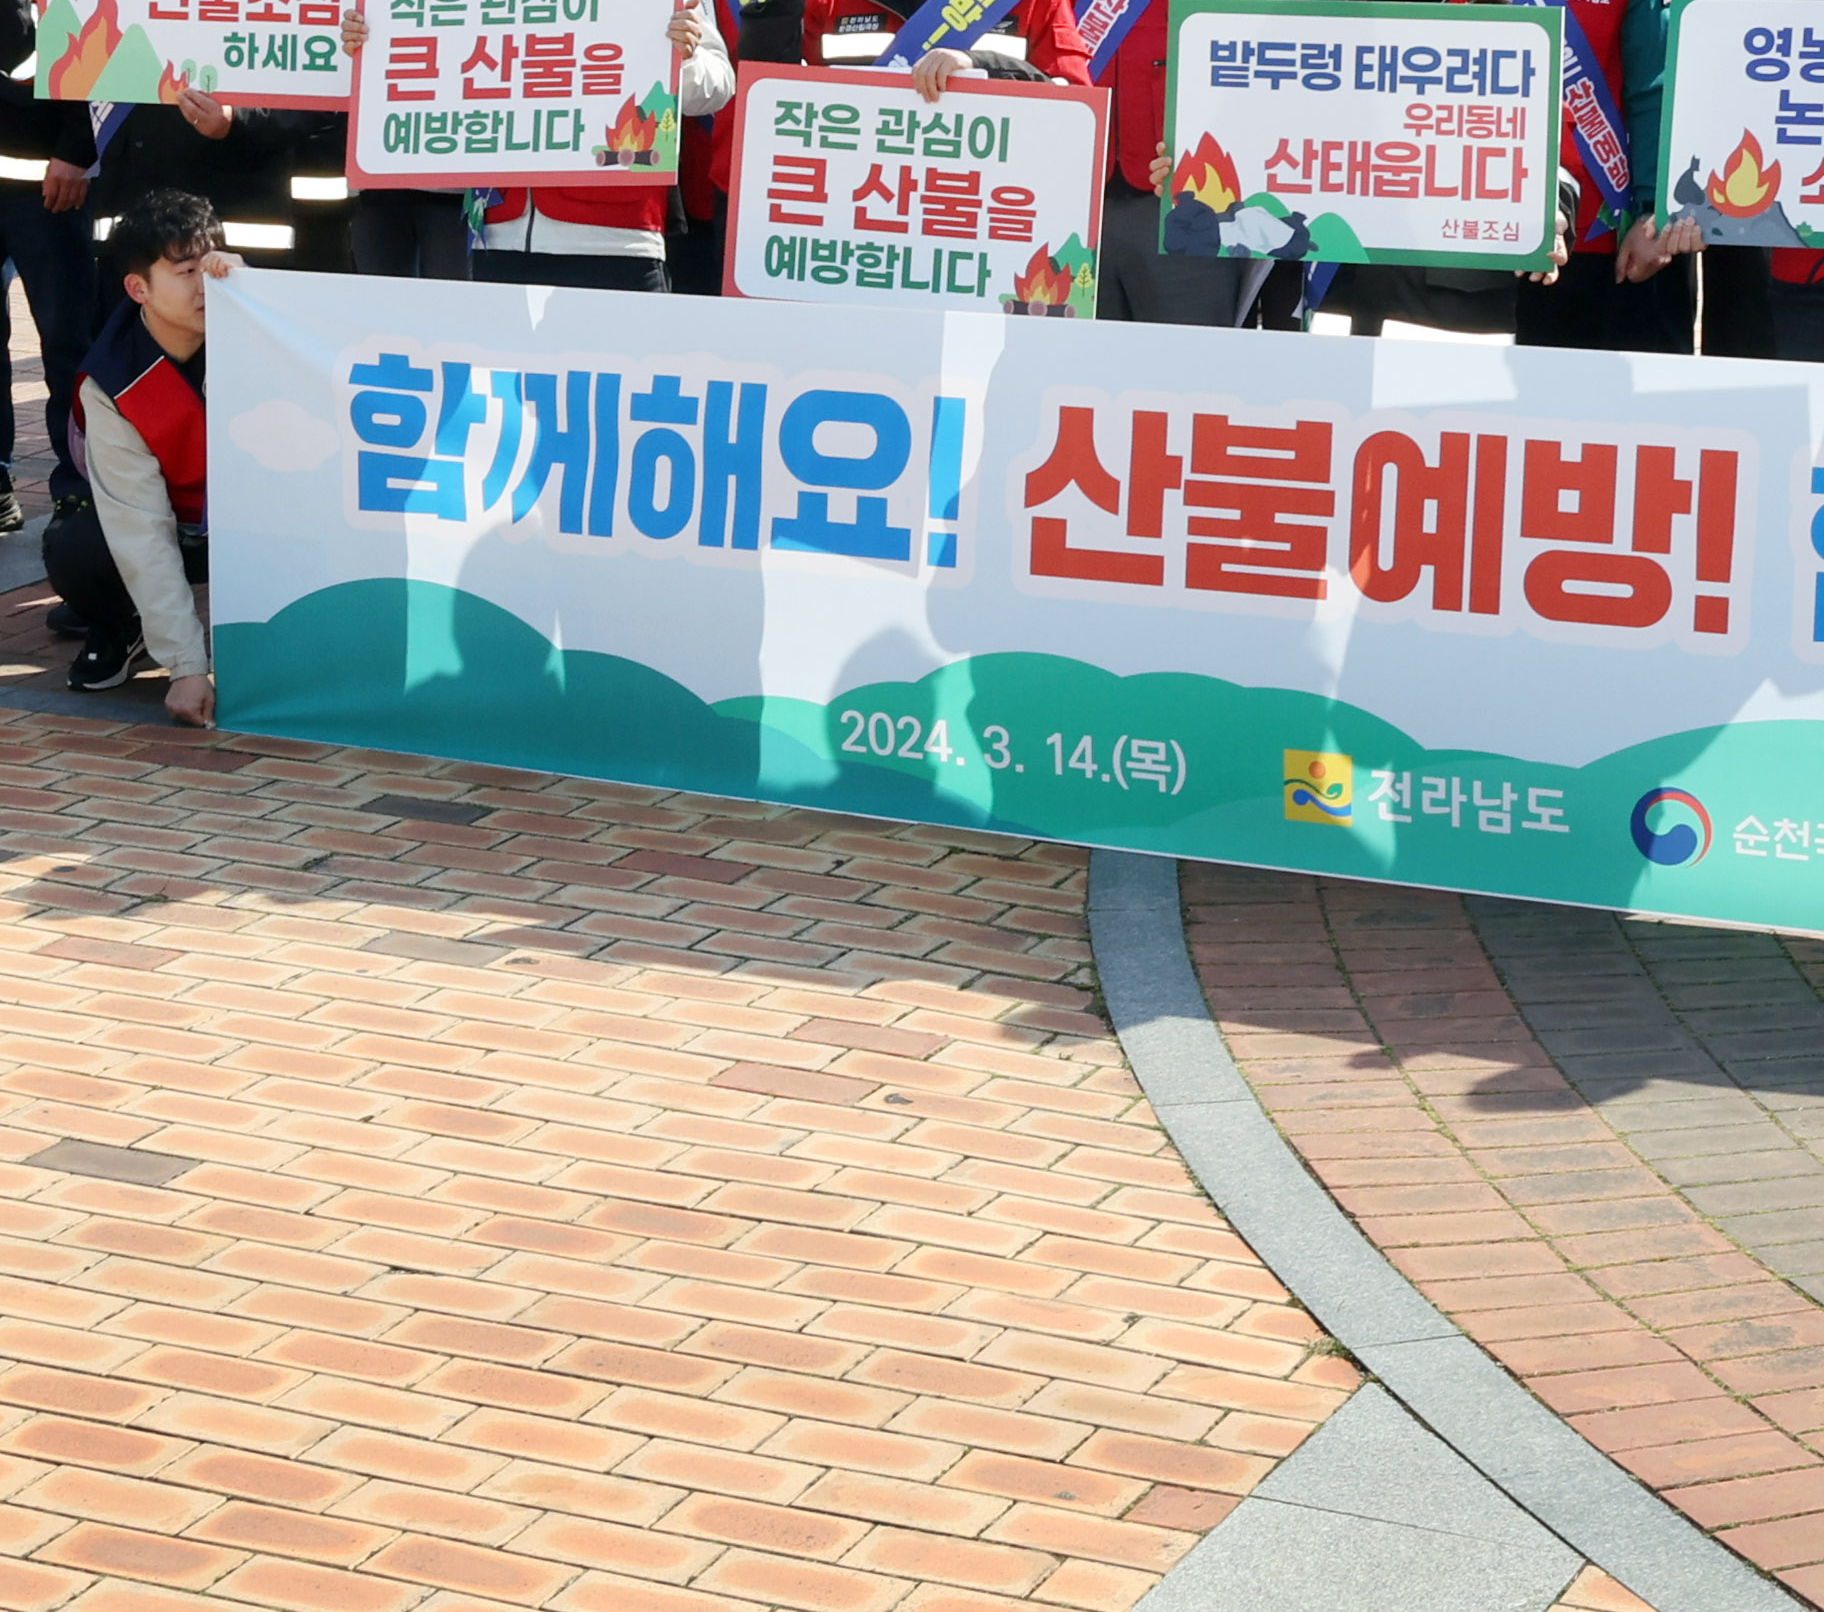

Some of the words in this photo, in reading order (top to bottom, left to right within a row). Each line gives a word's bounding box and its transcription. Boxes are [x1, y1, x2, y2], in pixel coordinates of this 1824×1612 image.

[223, 31, 338, 72] 하세요
[384, 37, 440, 102] 큰
[460, 33, 624, 97] 산불을
[1209, 40, 1341, 90] 밭두렁
[1354, 46, 1535, 97] 태우려다
[383, 108, 585, 154] 예방합니다
[774, 101, 861, 152] 작은
[876, 106, 1010, 162] 관심이
[1403, 104, 1526, 141] 우리동네
[1565, 77, 1630, 192] 산불예방
[767, 156, 828, 227] 큰
[852, 164, 1037, 242] 산불을
[1265, 137, 1528, 203] 산태웁니다
[1441, 218, 1520, 242] 산불조심
[763, 235, 992, 298] 예방합니다
[349, 352, 964, 571] 함께해요!
[1022, 403, 1739, 636] 산불예방!
[840, 710, 965, 767] 2024.
[983, 725, 1025, 773] 3.
[1368, 768, 1571, 835] 전라남도
